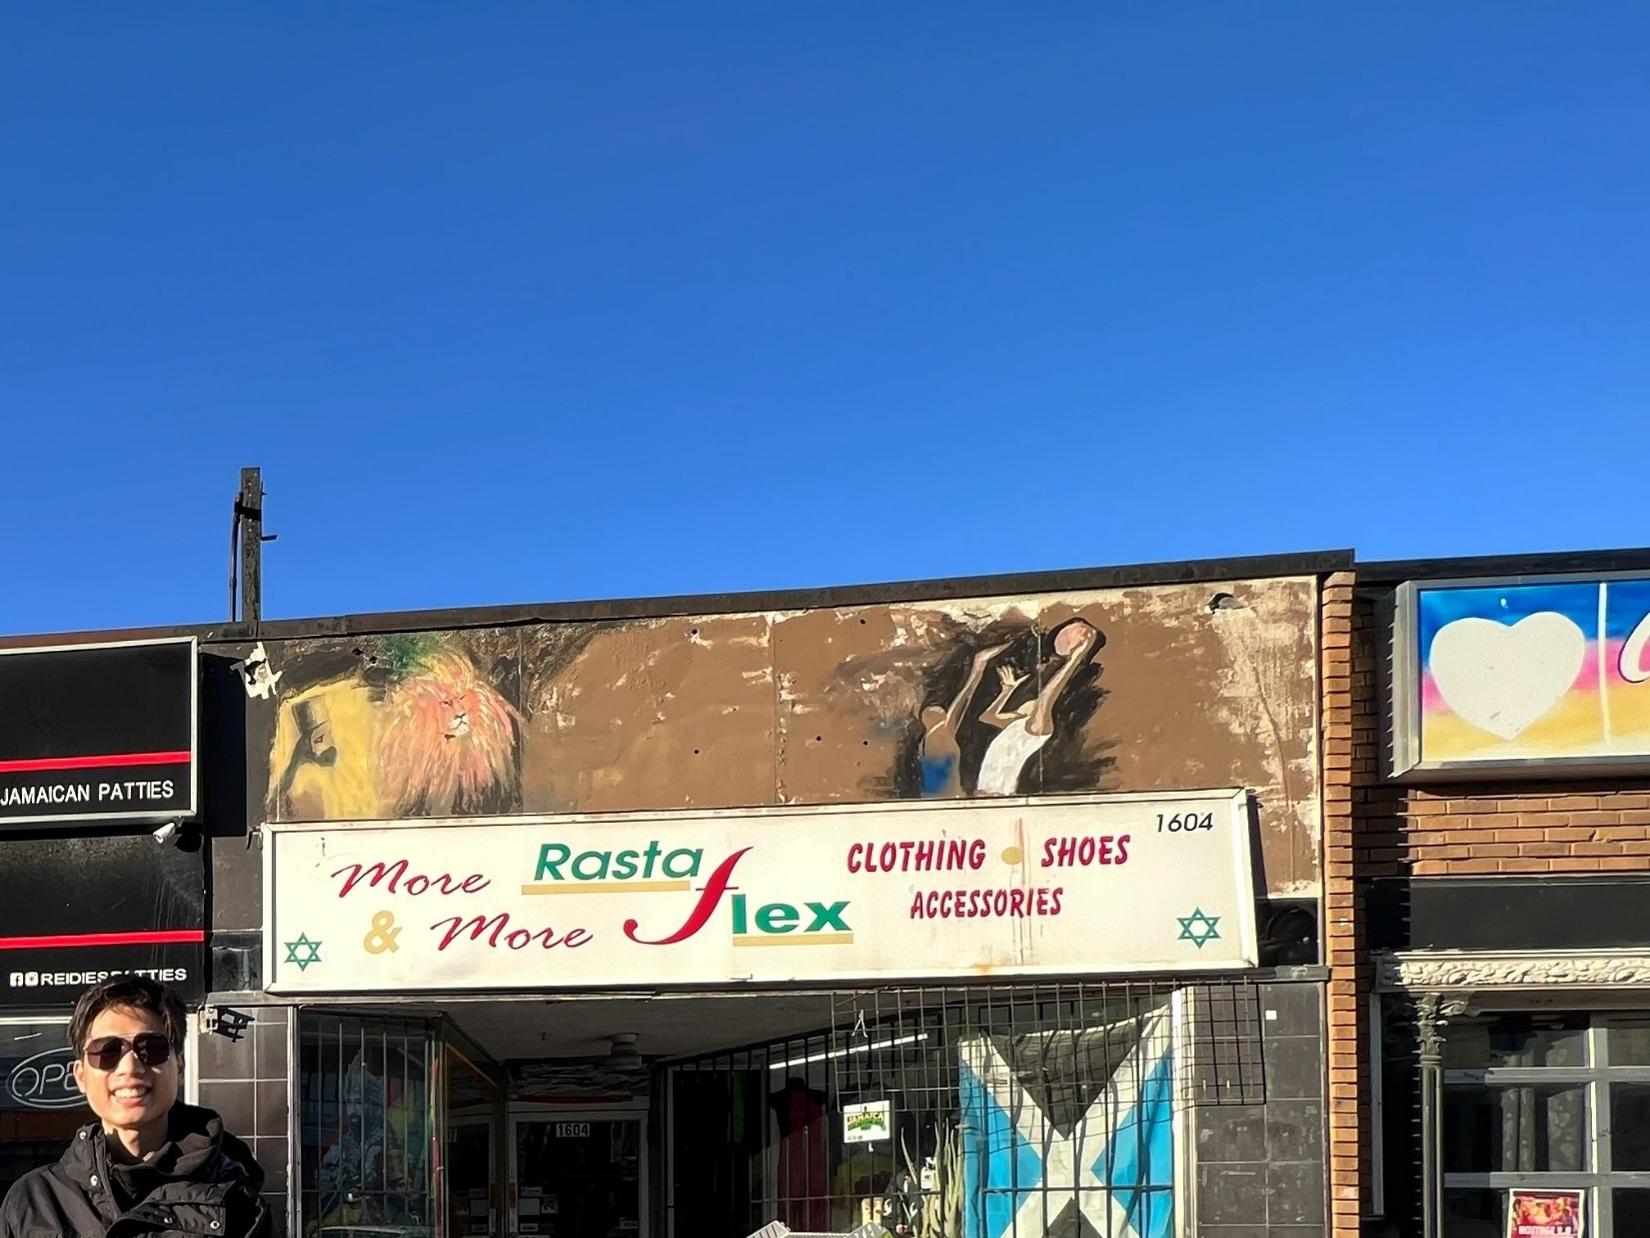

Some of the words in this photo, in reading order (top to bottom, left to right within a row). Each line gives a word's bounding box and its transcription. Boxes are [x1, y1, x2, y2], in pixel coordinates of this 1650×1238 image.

[0, 783, 91, 806] JAMAICAN
[98, 779, 175, 801] PATTIES
[1154, 811, 1214, 833] 1604
[534, 840, 704, 881] Rasta
[847, 839, 986, 874] CLOTHING
[1041, 834, 1131, 868] SHOES
[330, 858, 491, 898] More
[909, 886, 1064, 920] ACCESSORIES
[363, 909, 403, 955] &
[429, 912, 594, 951] More
[11, 1061, 79, 1098] OPE
[558, 1123, 589, 1137] 1604
